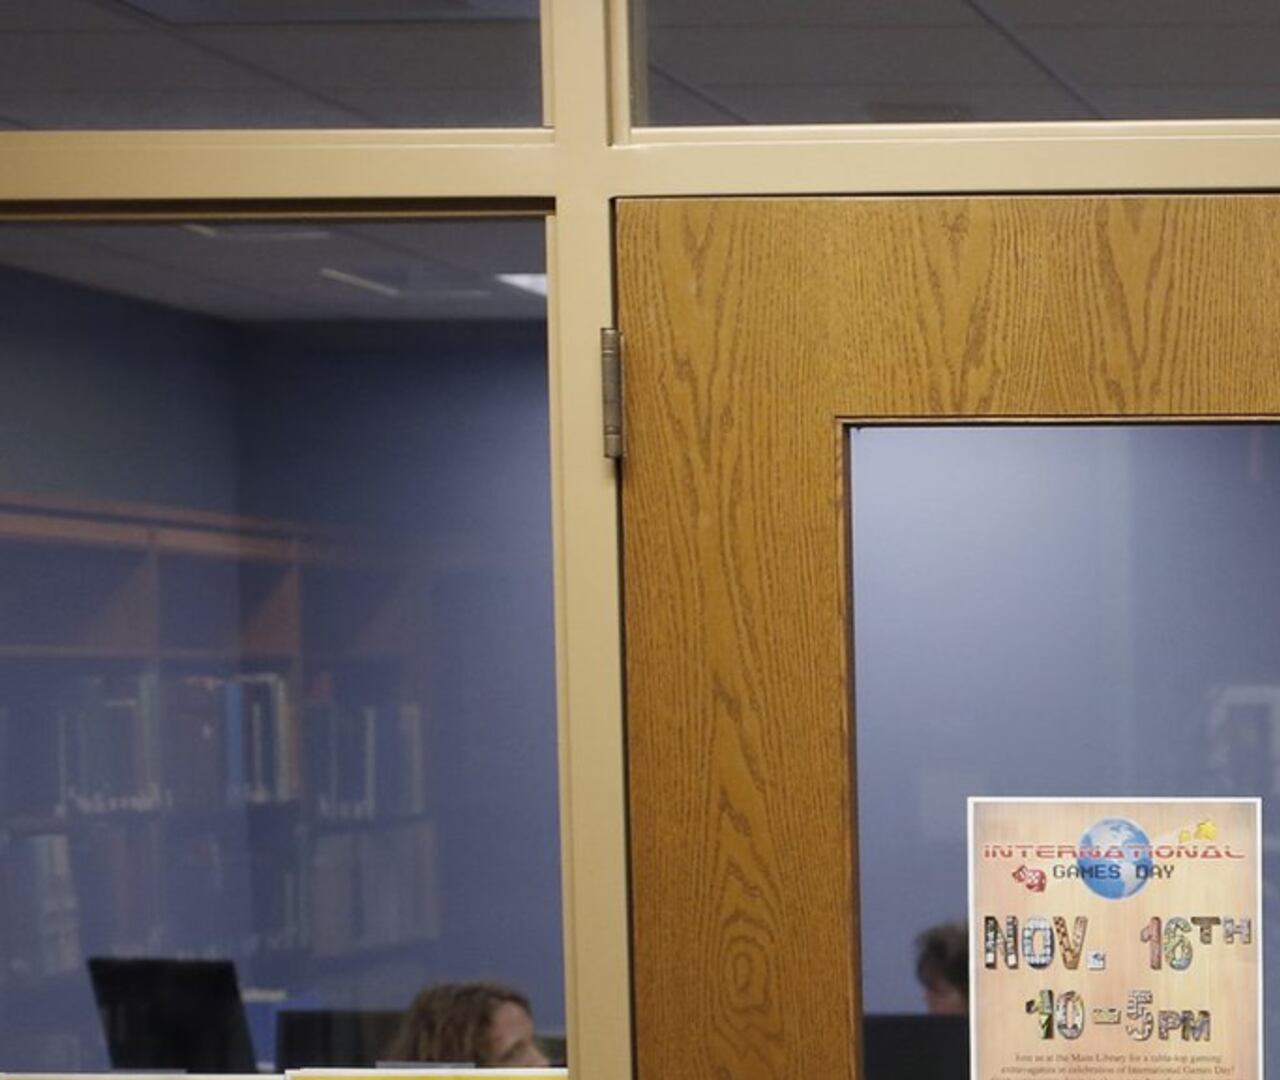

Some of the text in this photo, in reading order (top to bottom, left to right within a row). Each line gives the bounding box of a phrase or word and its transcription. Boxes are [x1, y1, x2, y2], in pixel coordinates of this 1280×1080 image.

[983, 844, 1247, 860] INTERNATIONAL
[1053, 863, 1176, 881] GAMES DAY
[984, 914, 1252, 972] NOV. 16TH
